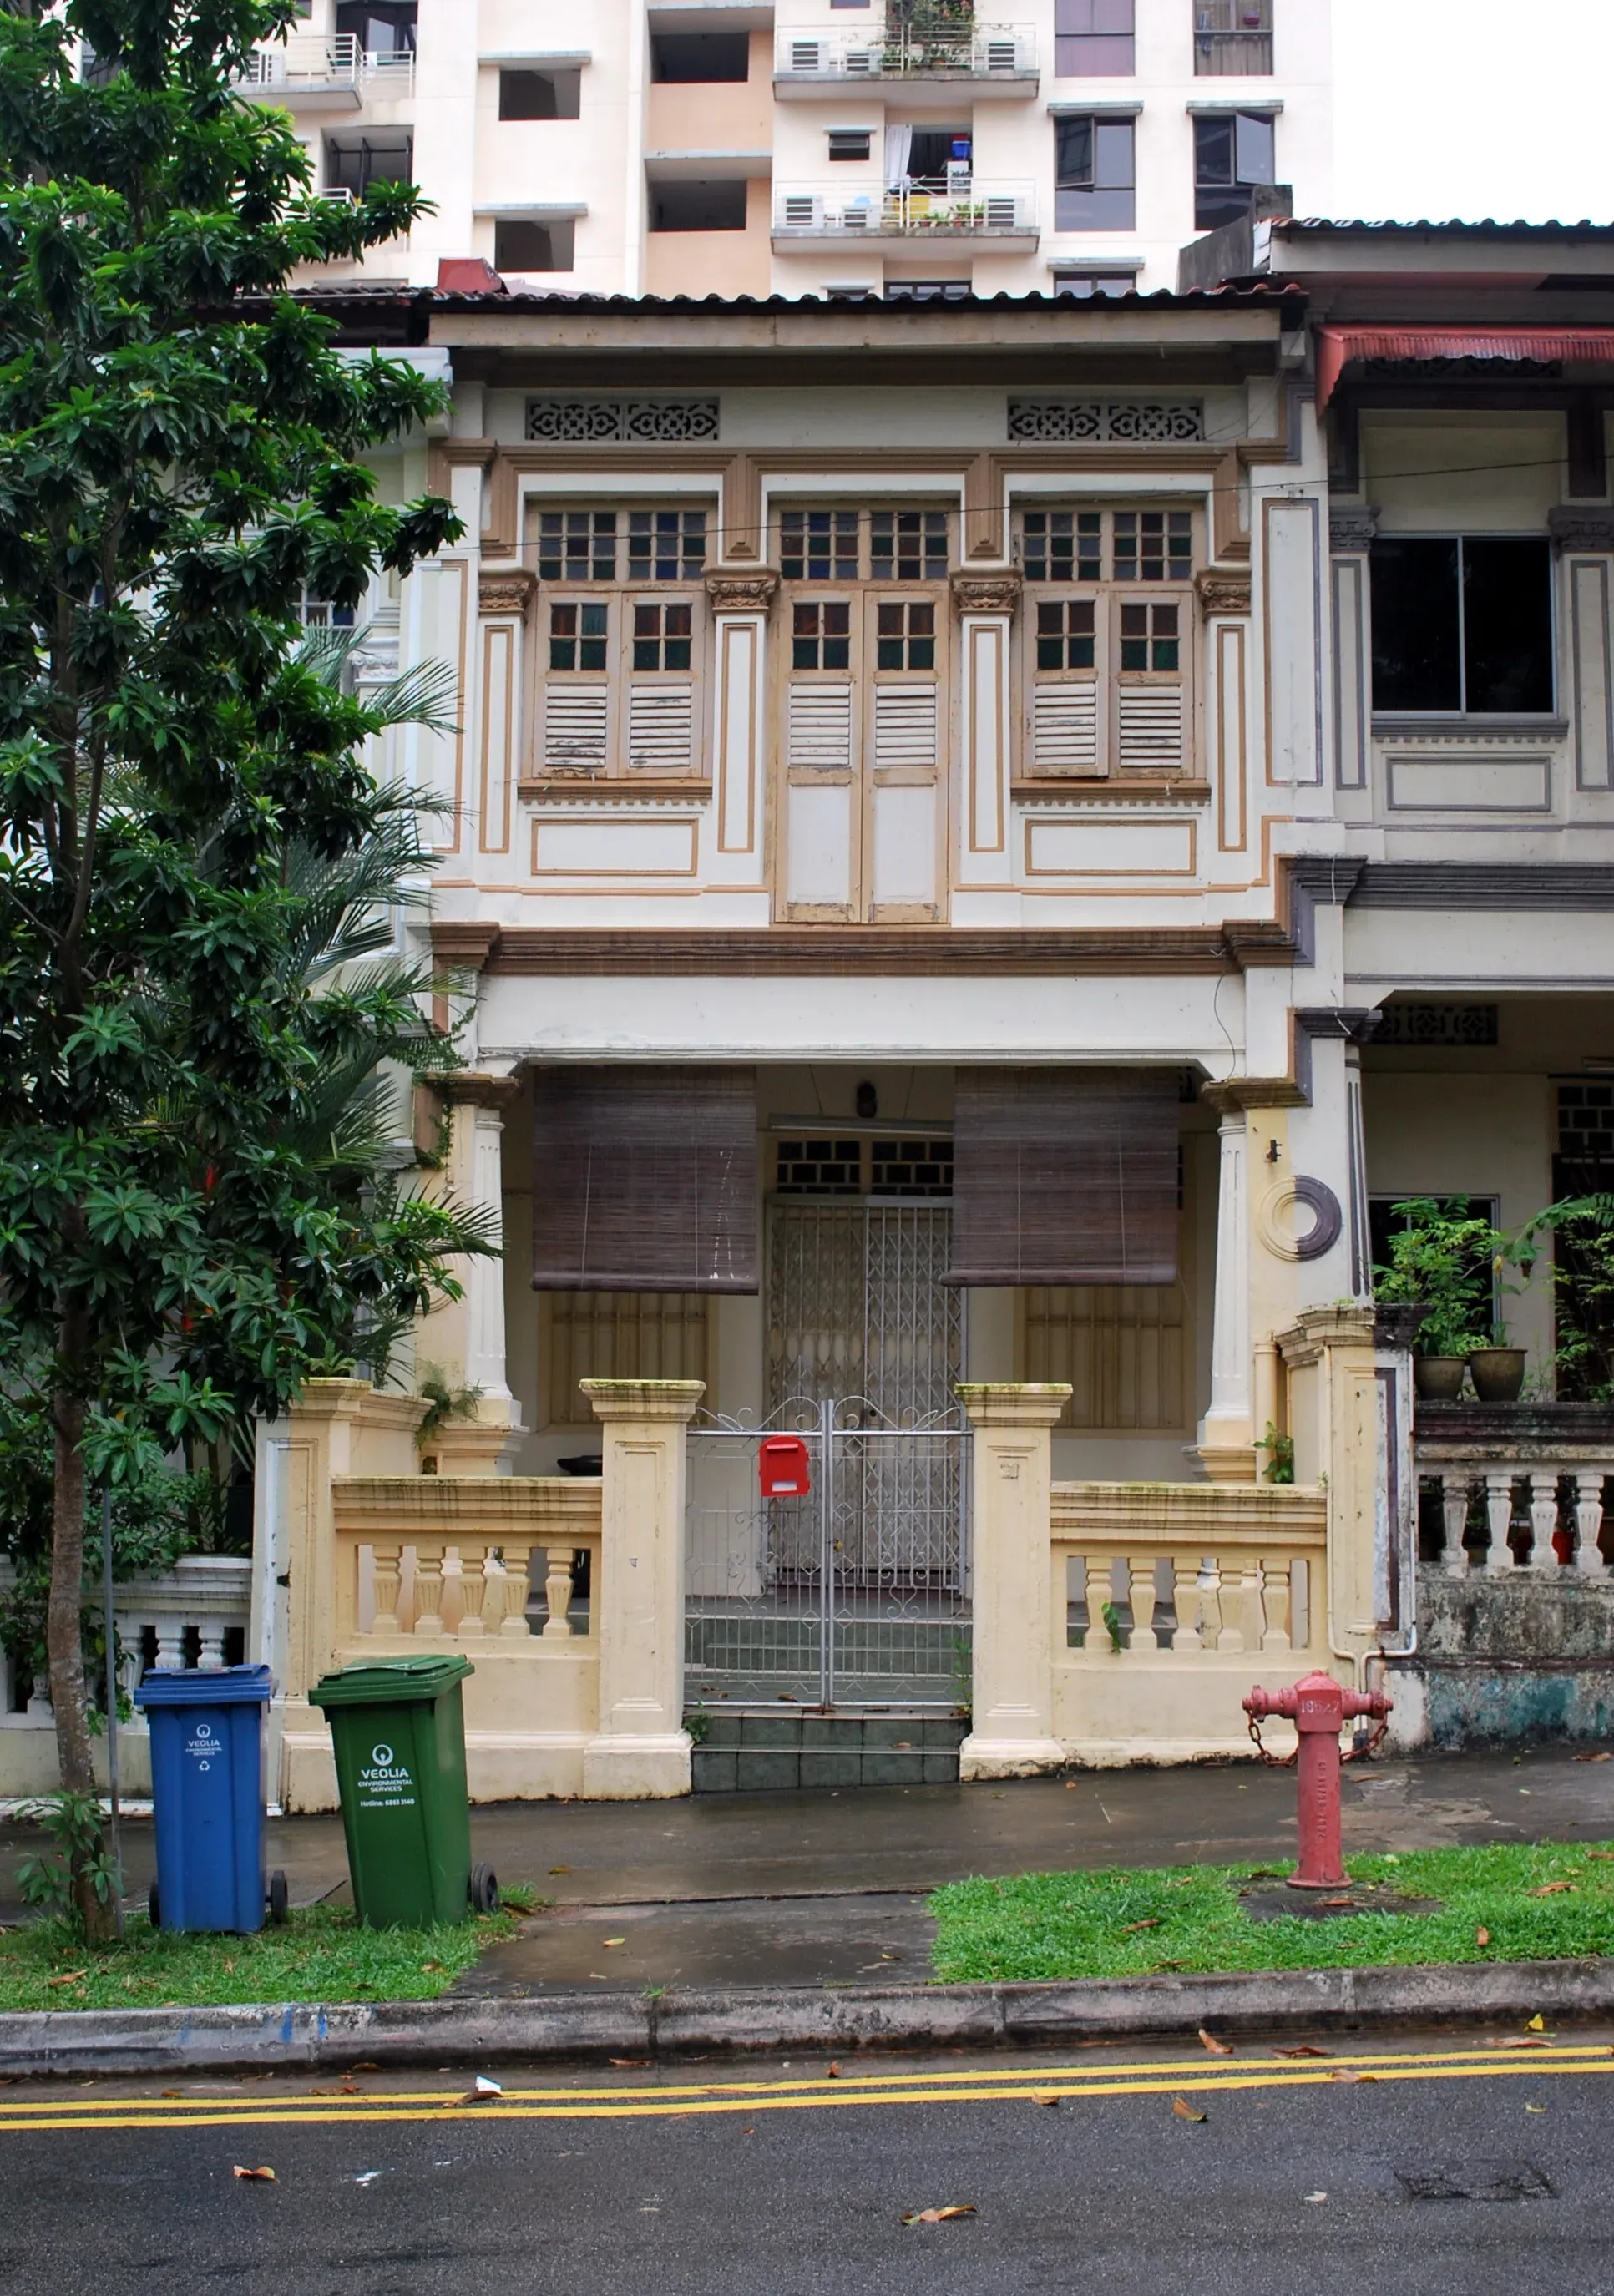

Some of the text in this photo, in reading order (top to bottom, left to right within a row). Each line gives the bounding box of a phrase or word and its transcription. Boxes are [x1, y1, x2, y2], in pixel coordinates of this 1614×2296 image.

[188, 1739, 220, 1747] VEOLIA
[361, 1768, 409, 1779] VEOLIA
[357, 1779, 413, 1788] ENVIRONMENTAL
